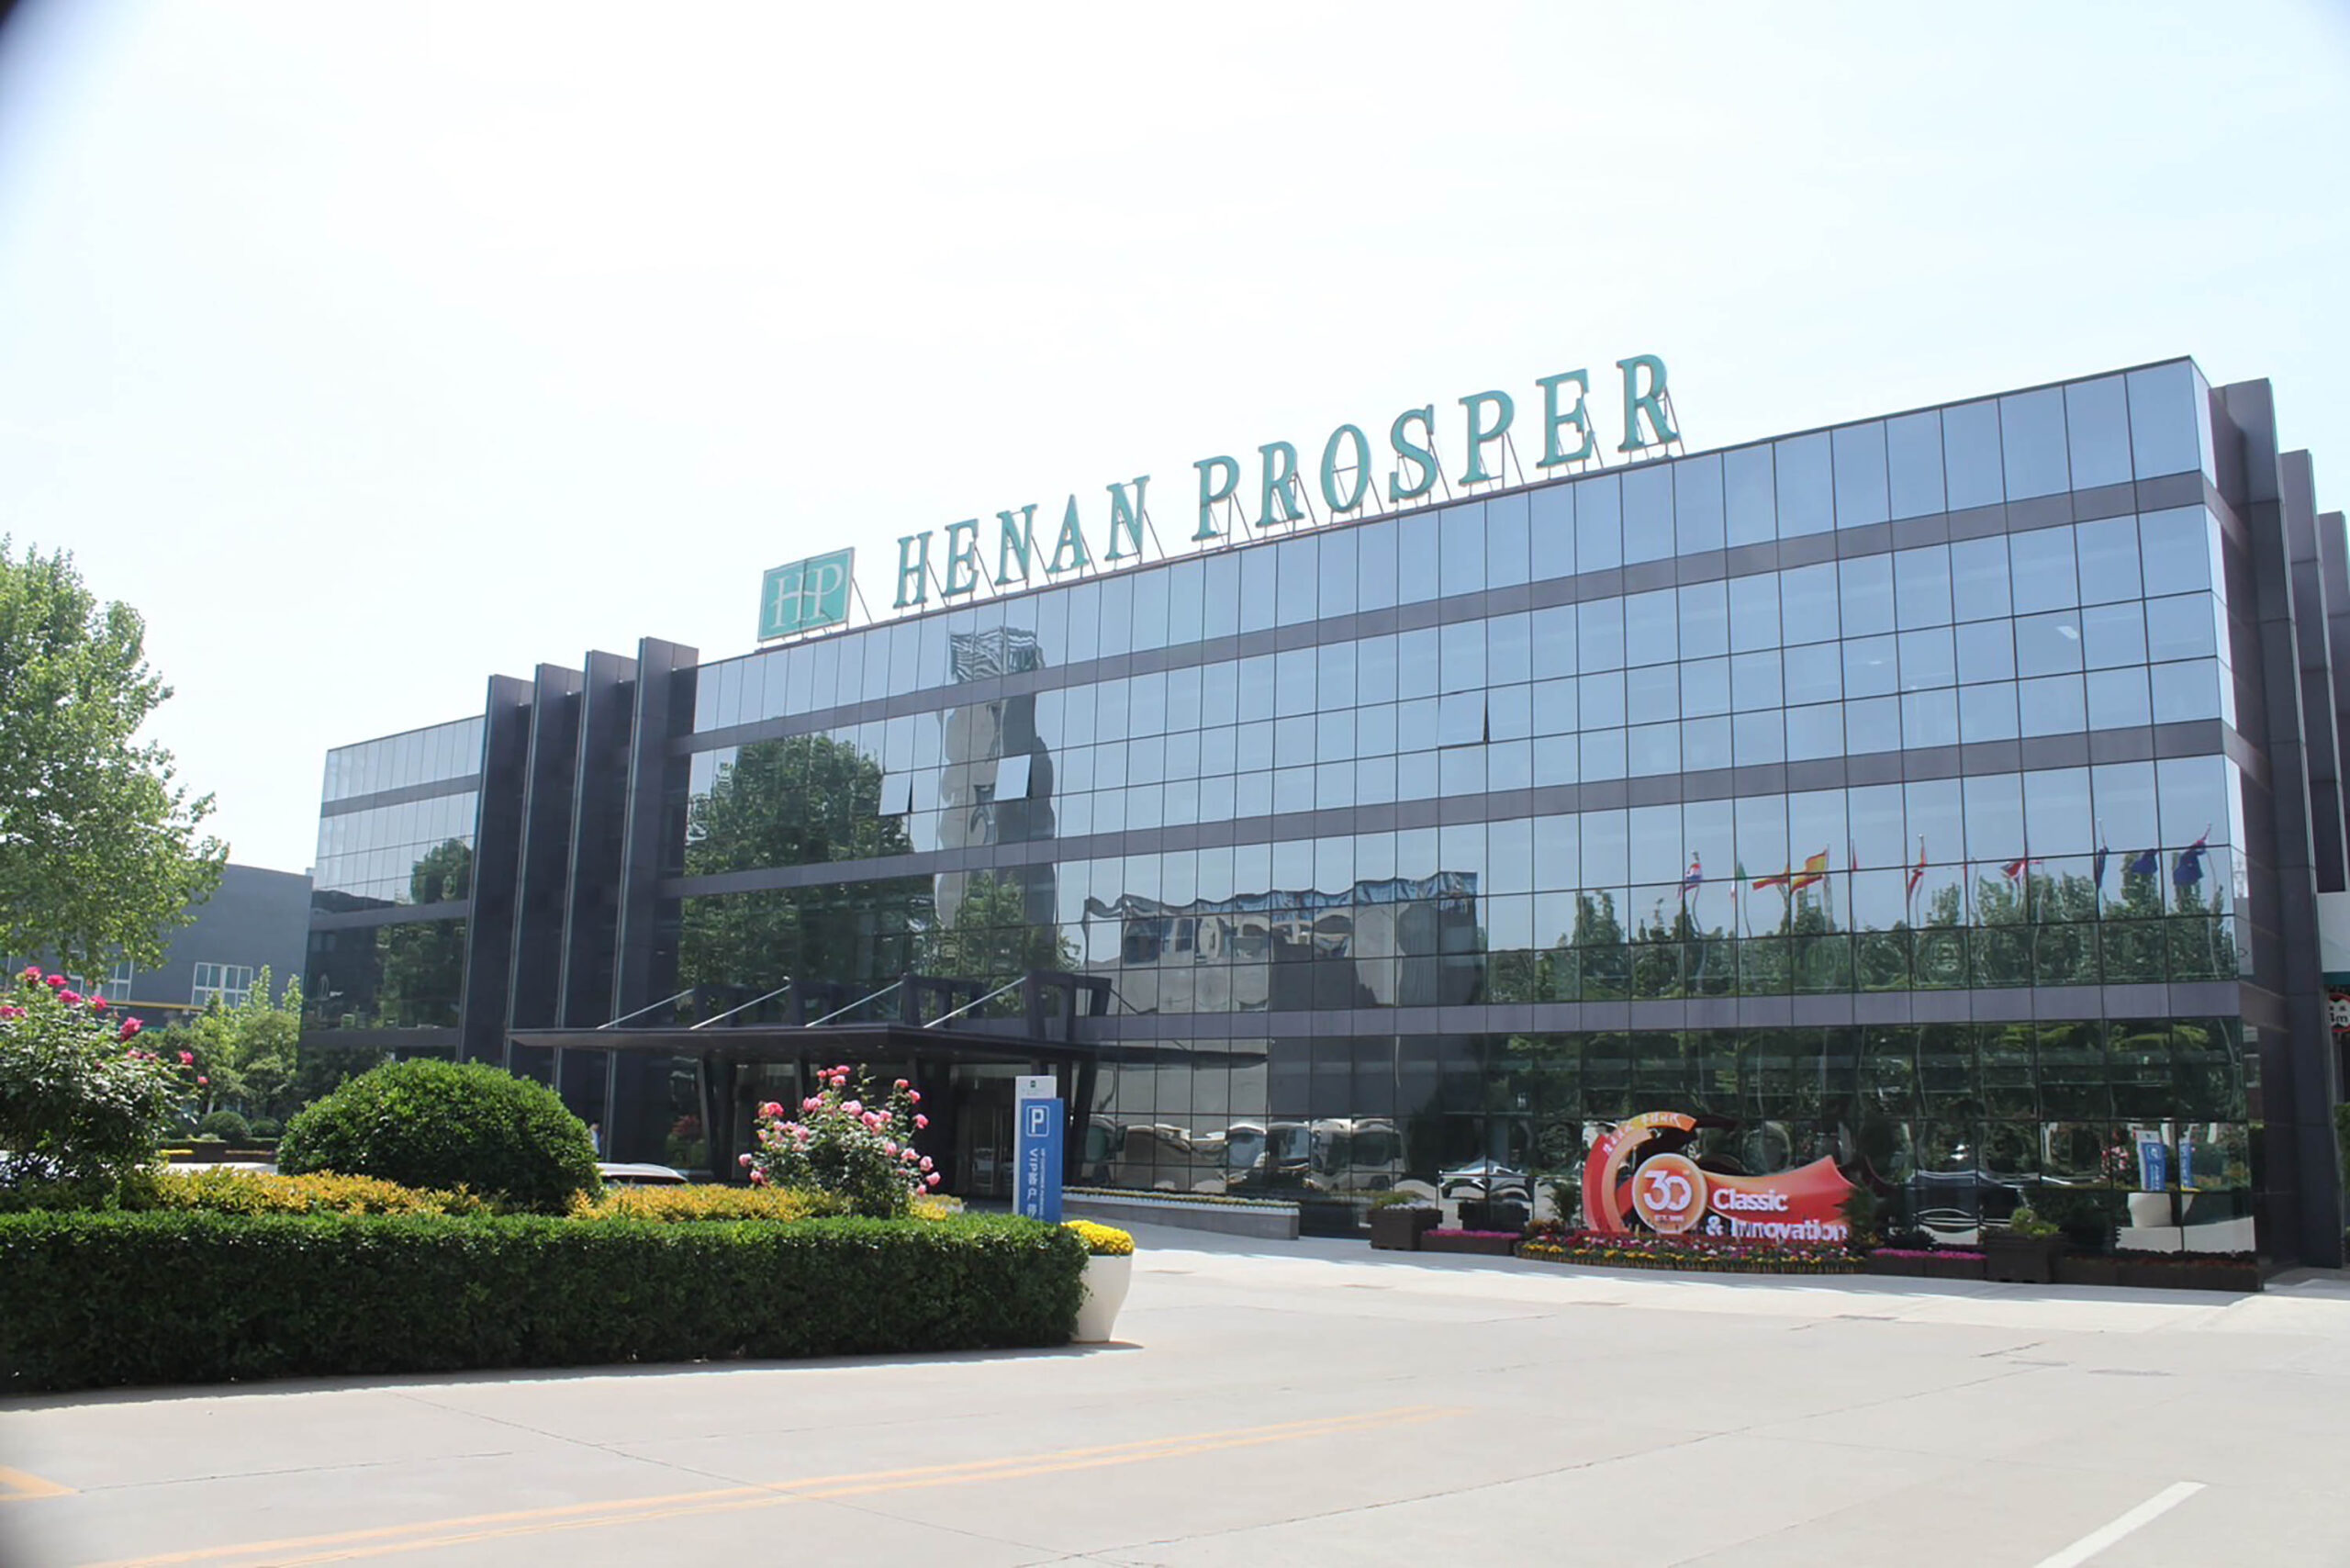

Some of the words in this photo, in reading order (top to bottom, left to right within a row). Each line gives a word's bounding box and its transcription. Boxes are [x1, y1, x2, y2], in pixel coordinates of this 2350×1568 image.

[893, 475, 1150, 609] HENAN
[1192, 353, 1680, 543] PROSPER
[770, 563, 844, 628] HP
[1031, 1108, 1045, 1134] P
[1643, 1170, 1693, 1211] 30
[1713, 1188, 1788, 1211] Classic
[1706, 1215, 1724, 1237] &
[1730, 1217, 1849, 1241] Innovation
